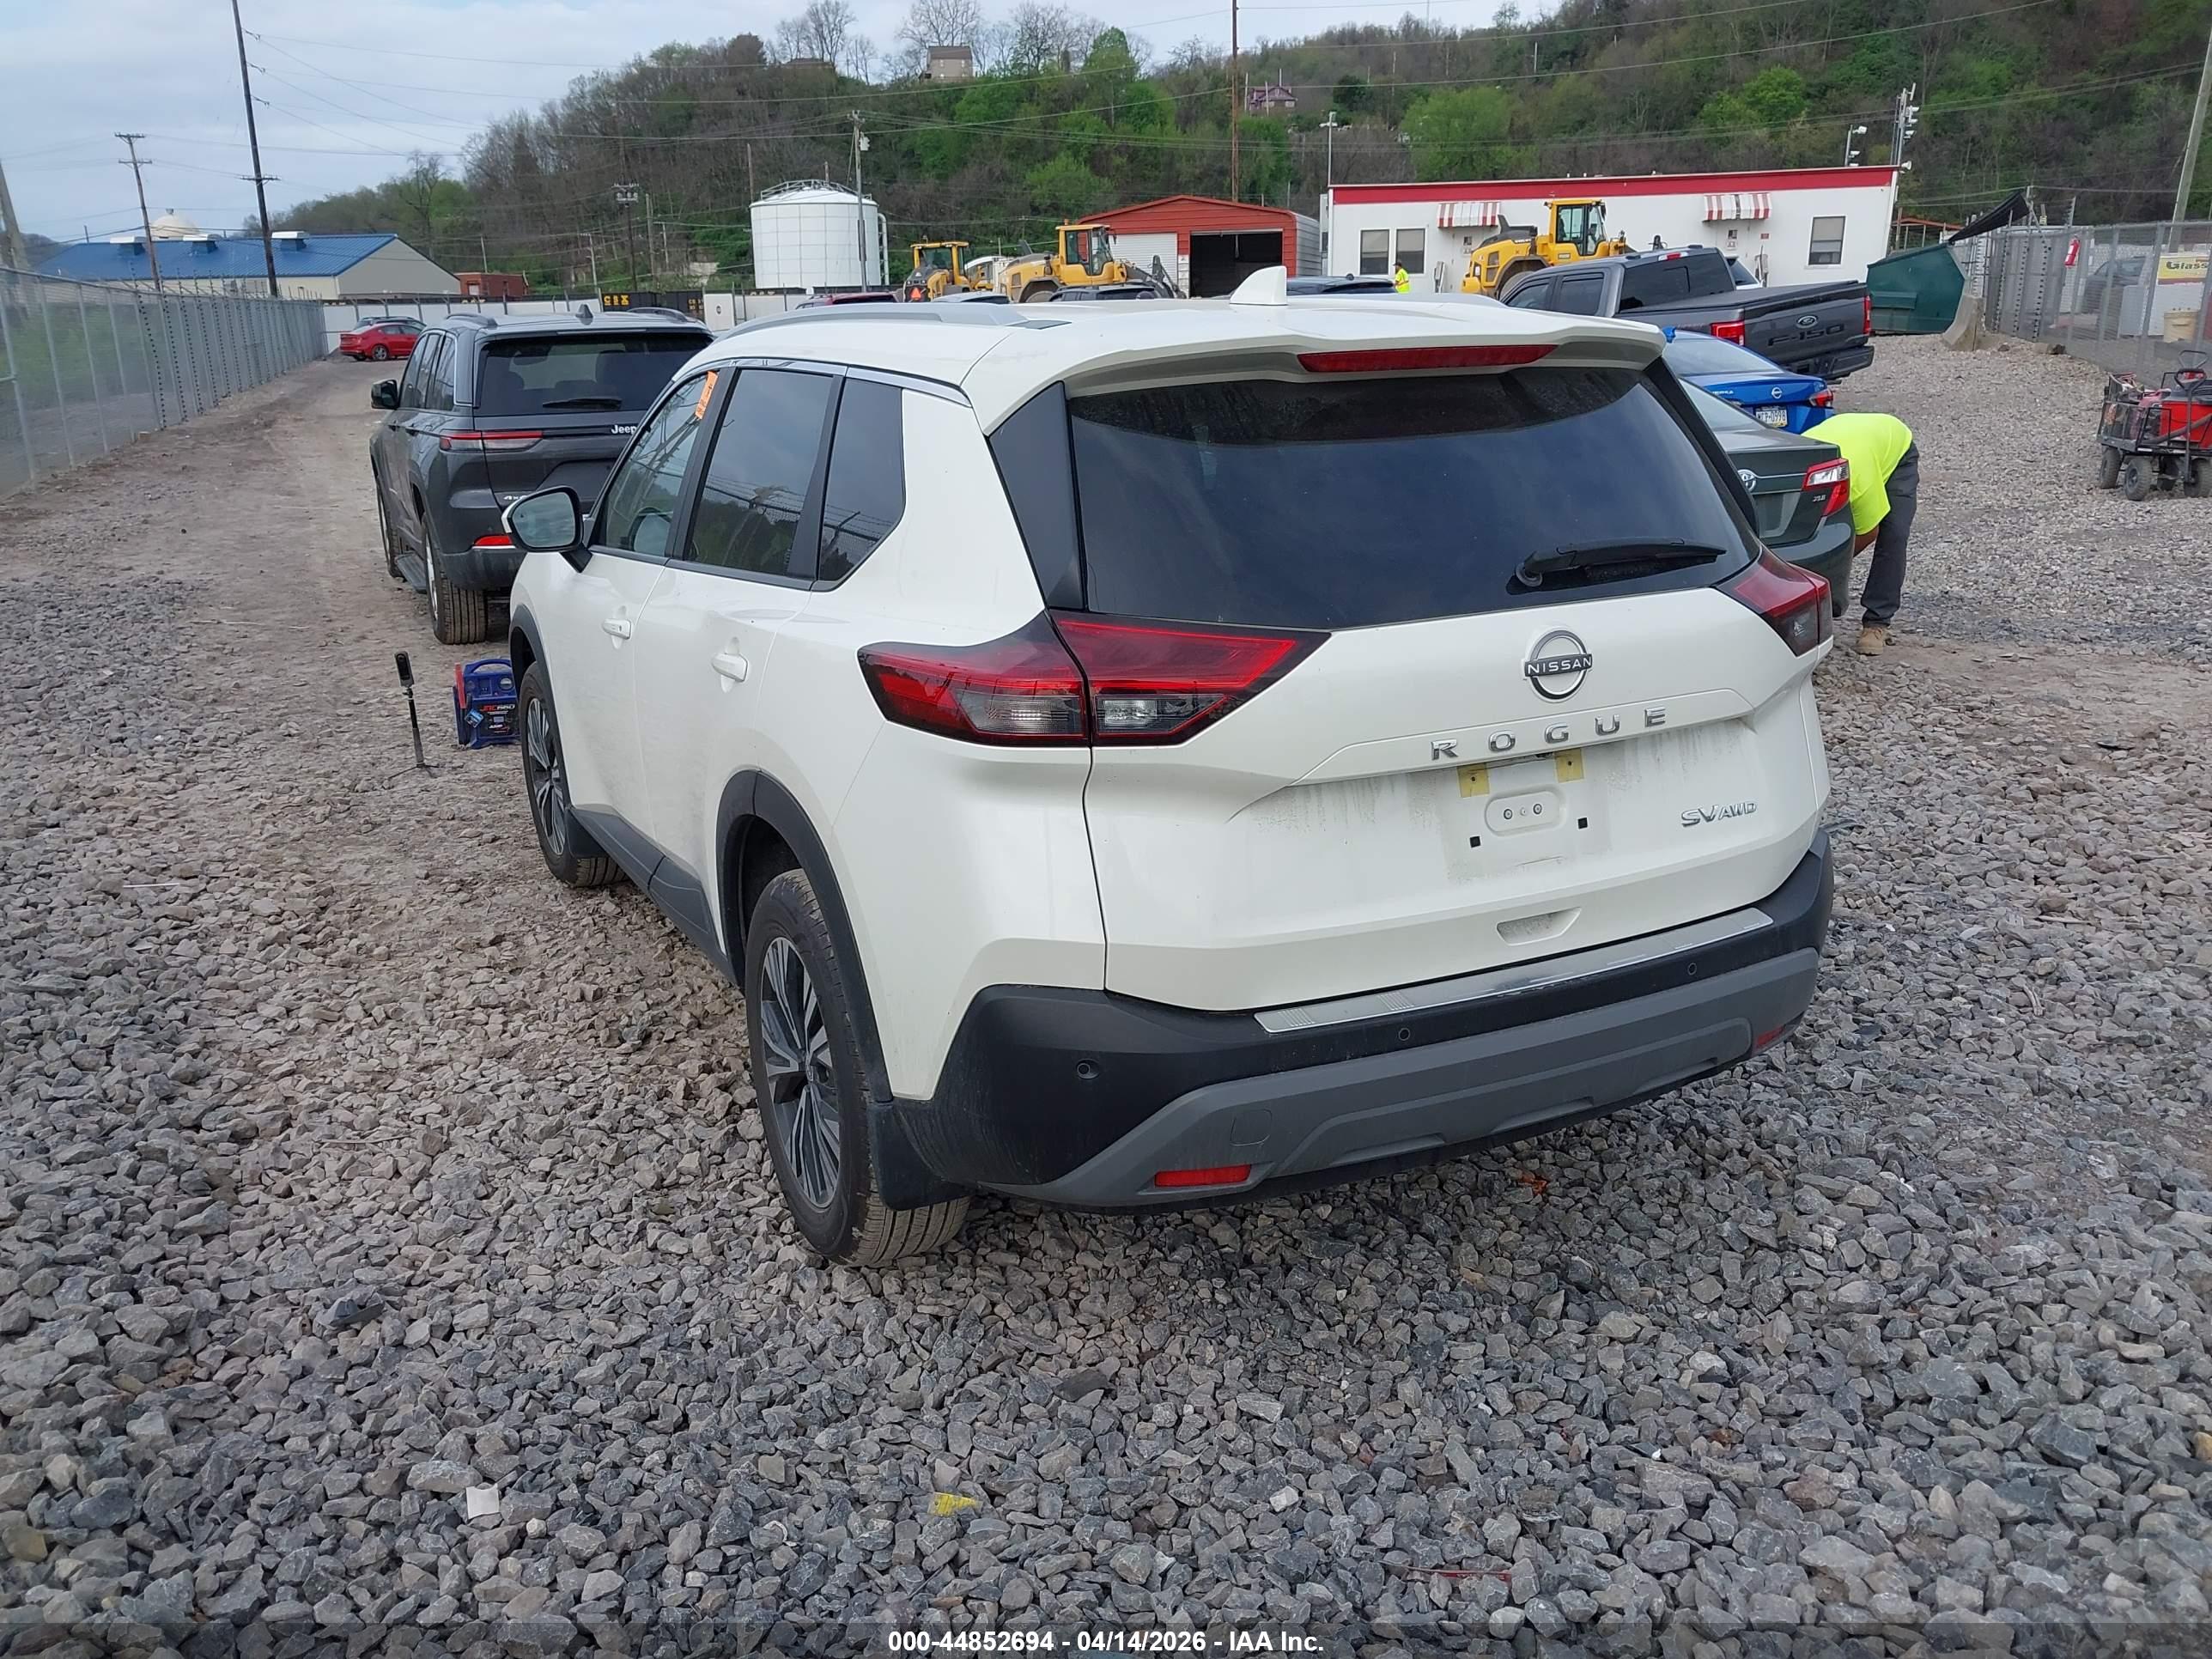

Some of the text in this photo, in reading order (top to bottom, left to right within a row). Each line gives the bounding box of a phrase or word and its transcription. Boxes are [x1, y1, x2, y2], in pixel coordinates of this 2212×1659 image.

[2166, 261, 2208, 270] Glass
[604, 295, 629, 306] CSX
[1767, 324, 1844, 346] F-150
[611, 424, 637, 434] Jeep
[1528, 656, 1592, 674] NISSAN
[1431, 707, 1666, 761] ROGUE
